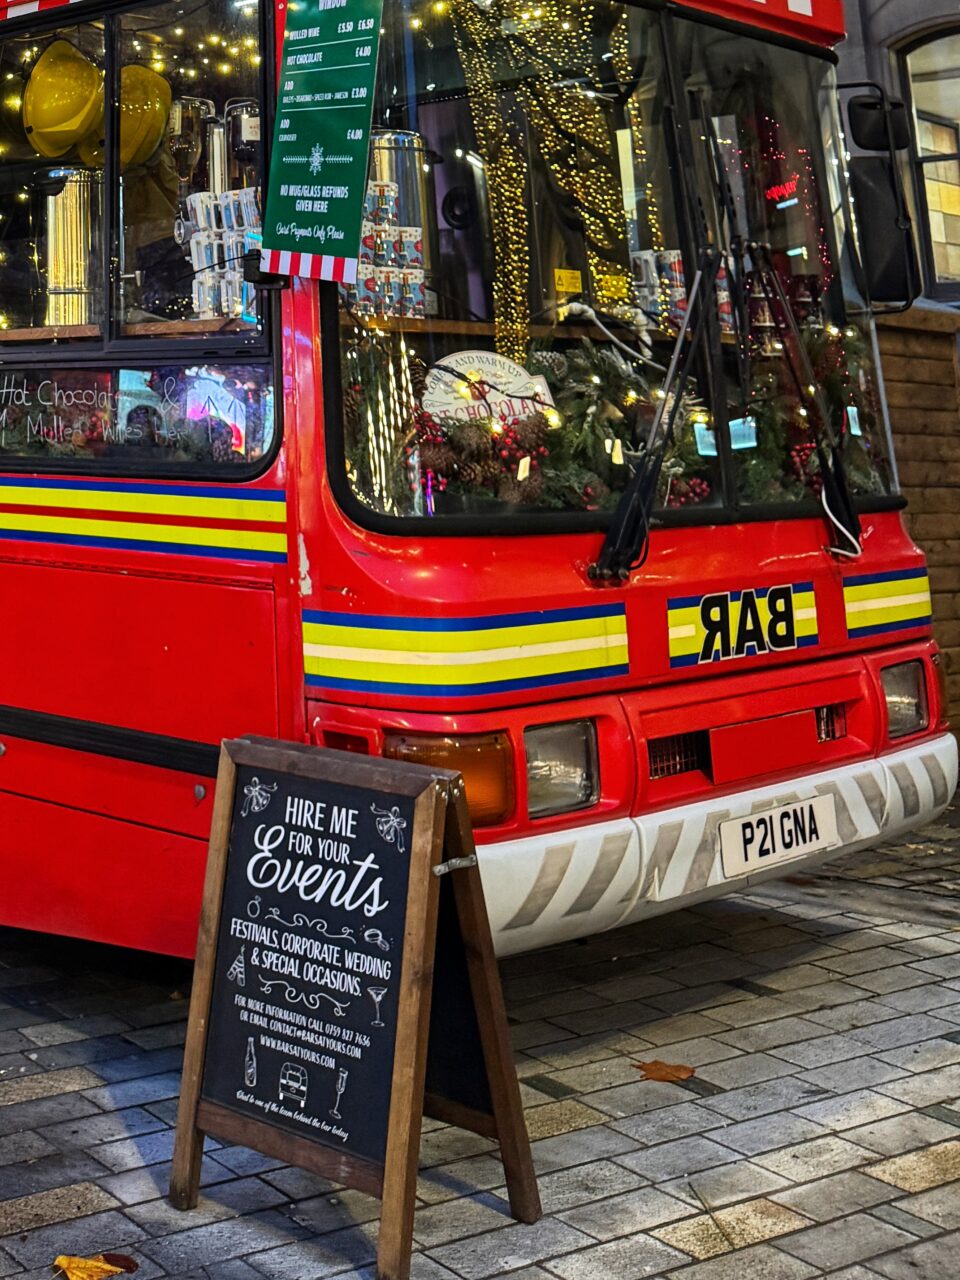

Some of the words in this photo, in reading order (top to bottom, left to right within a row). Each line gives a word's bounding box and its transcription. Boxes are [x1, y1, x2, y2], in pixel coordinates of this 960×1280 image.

[289, 29, 308, 41] MULLED
[308, 27, 320, 38] WINE
[337, 21, 354, 34] £5.50
[357, 18, 375, 31] £6.50
[286, 56, 296, 66] HOT
[296, 52, 323, 65] CHOCOLATE
[355, 46, 372, 58] £4.00
[284, 81, 294, 91] ADD
[351, 87, 368, 99] £3.00
[280, 119, 290, 129] ADD
[346, 129, 363, 140] £4.00
[280, 184, 289, 196] NO
[288, 185, 321, 198] MUG/GLASS
[321, 185, 349, 199] REFUNDS
[295, 199, 313, 212] GIVEN
[312, 200, 329, 213] HERE
[276, 221, 290, 235] Card
[290, 222, 313, 242] Payments
[313, 224, 326, 244] Only
[326, 225, 345, 239] Please
[455, 355, 475, 369] AND
[476, 355, 507, 371] WARM
[507, 365, 522, 378] UP
[160, 376, 181, 413] &
[285, 796, 326, 831] HIRE
[329, 806, 359, 838] ME
[780, 804, 819, 849] GNA
[288, 831, 312, 856] FOR
[317, 837, 350, 865] YOUR
[246, 824, 389, 917] Events
[250, 947, 260, 966] &
[261, 951, 302, 979] SPECIAL
[303, 961, 362, 997] OCCASIONS.
[344, 949, 392, 980] WEDDING
[234, 994, 247, 1007] FOR
[247, 998, 265, 1014] MORE
[265, 1004, 307, 1027] INFORMATION
[307, 1018, 324, 1033] CALL
[325, 1023, 341, 1037] 0759
[341, 1028, 354, 1041] 827
[355, 1033, 371, 1048] 7636
[240, 1009, 250, 1021] OR
[250, 1013, 269, 1032] EMAIL
[269, 1019, 362, 1060] CONTACT@BARSATYOURS.COM
[260, 1034, 336, 1070] WWW.BARSATYOURS.COM
[248, 1094, 255, 1104] to
[254, 1099, 264, 1107] one
[264, 1101, 272, 1113] of
[270, 1102, 279, 1113] the
[279, 1106, 293, 1118] team
[293, 1111, 312, 1126] behind
[311, 1116, 321, 1129] the
[320, 1120, 332, 1132] bar
[331, 1125, 350, 1143] today
